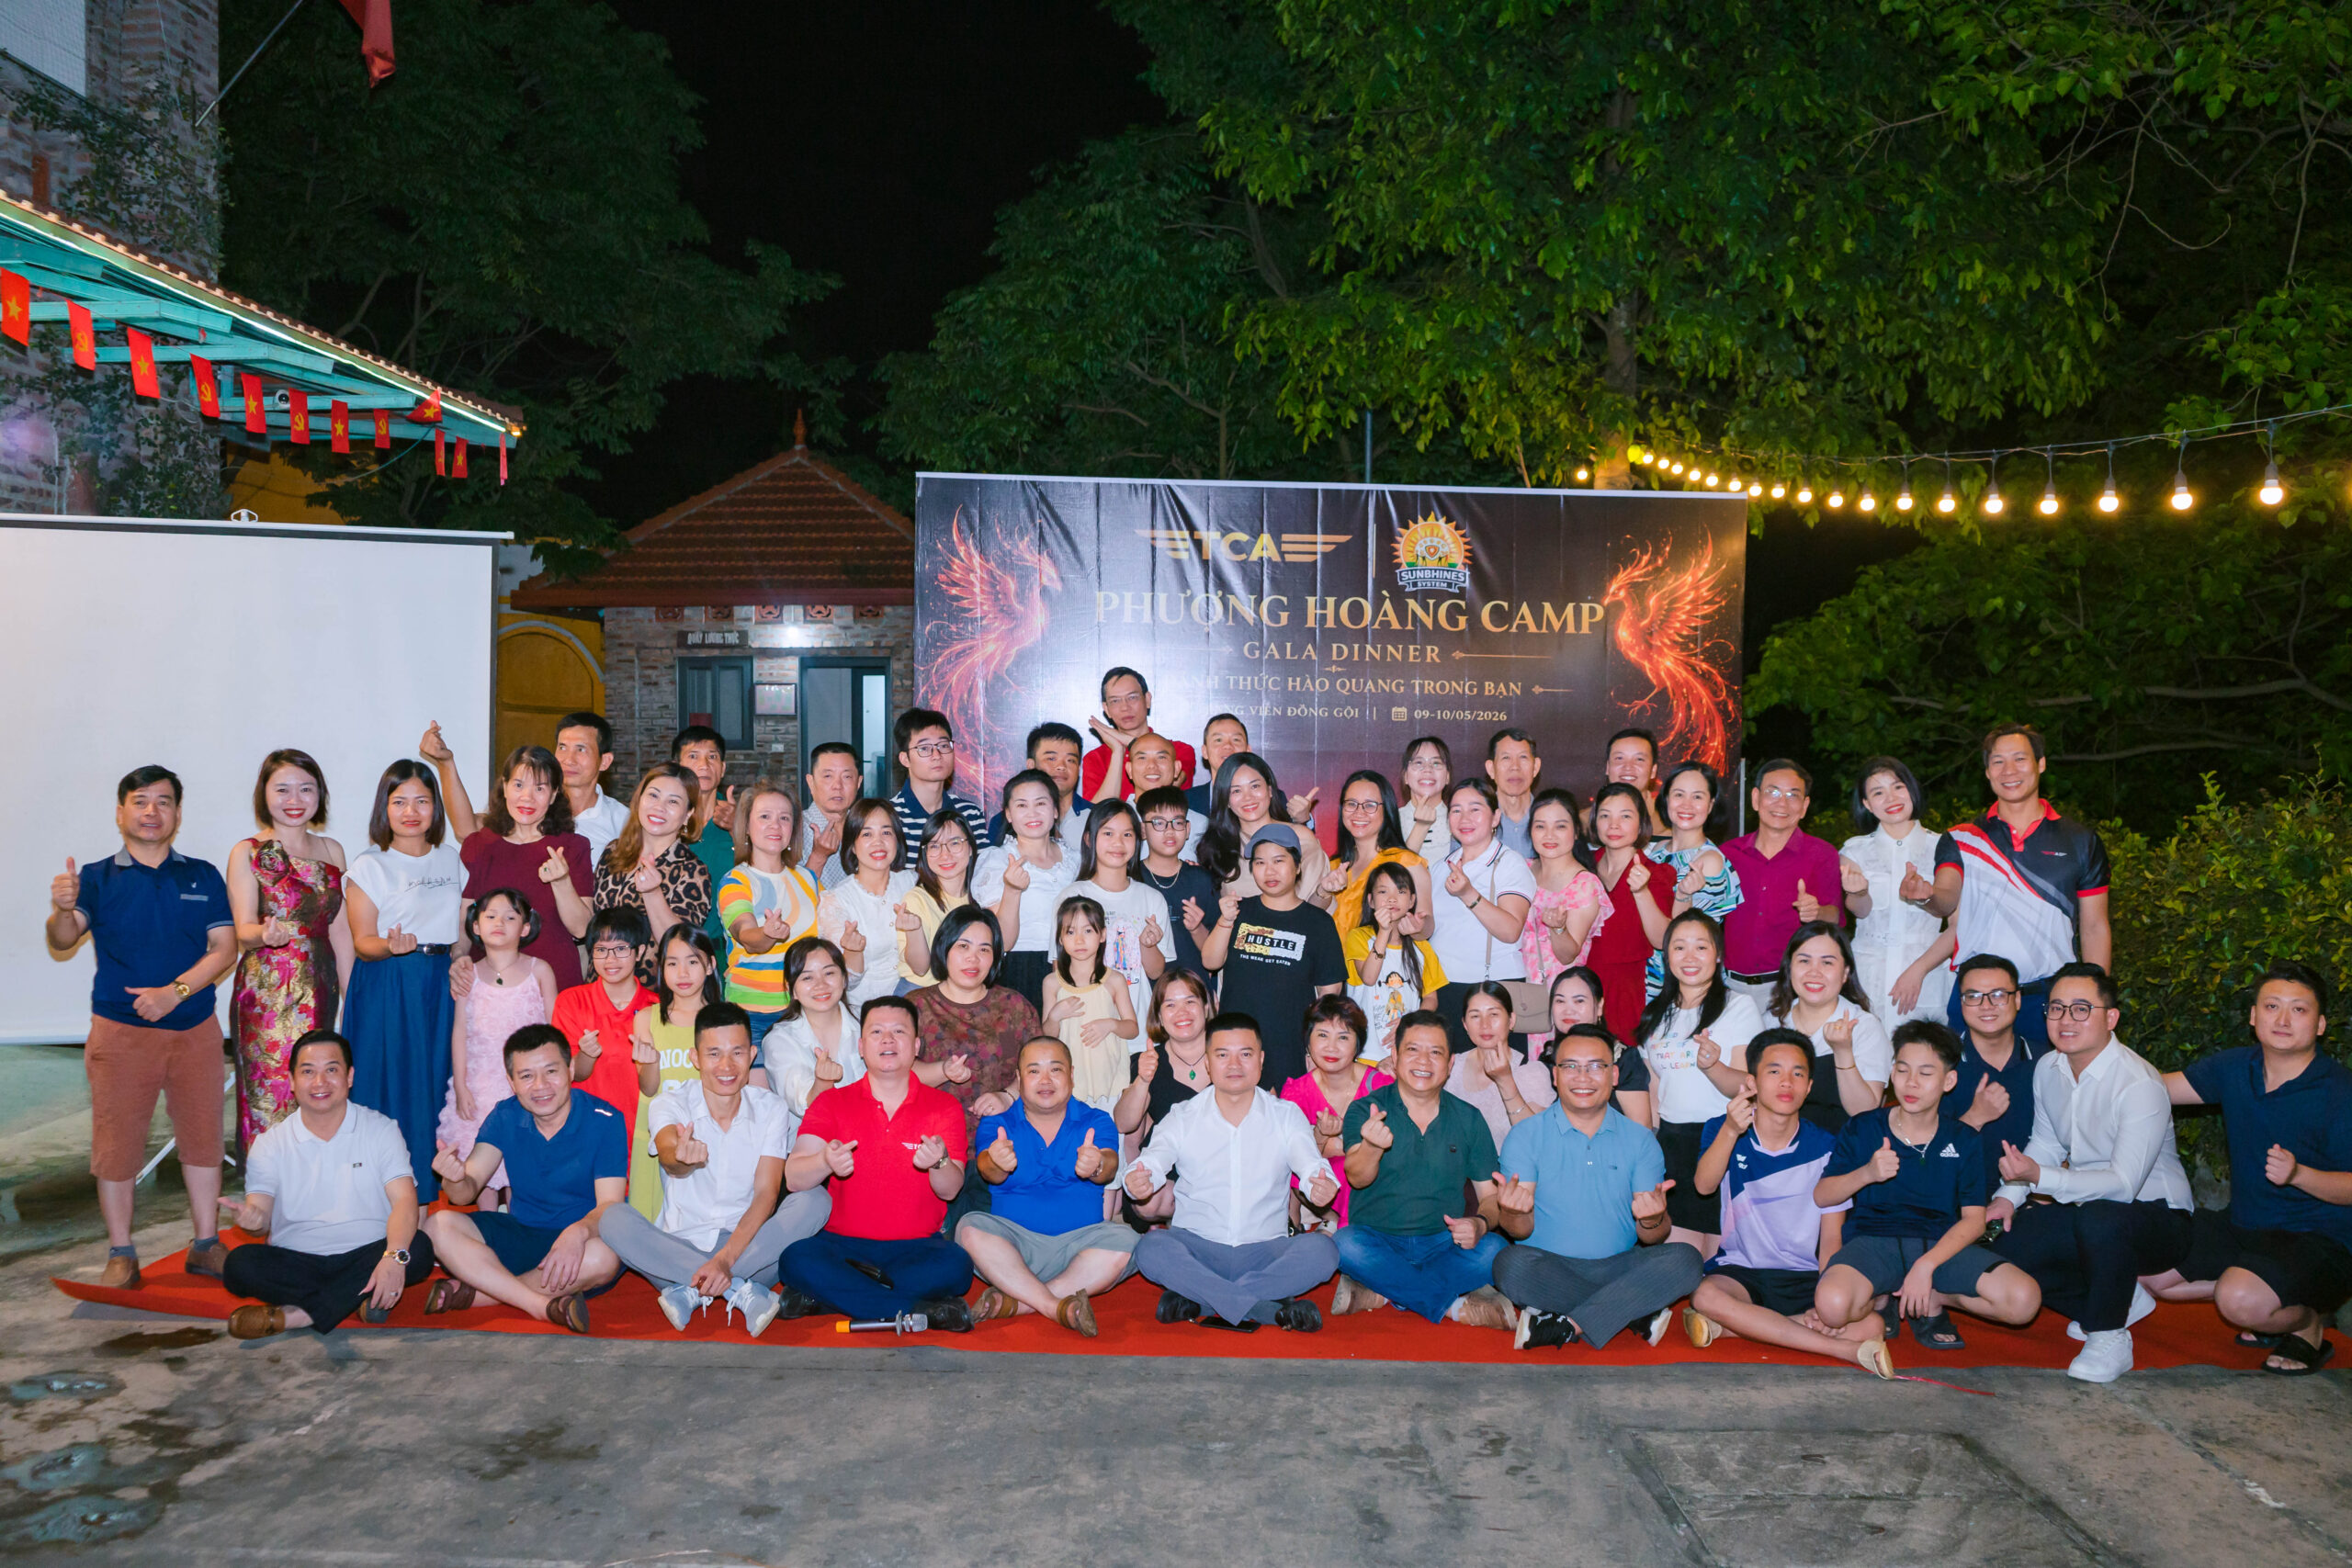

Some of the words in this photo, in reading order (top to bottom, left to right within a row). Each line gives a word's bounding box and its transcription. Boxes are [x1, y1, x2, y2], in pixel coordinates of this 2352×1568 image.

[1400, 570, 1465, 582] SUNBHINES
[1095, 589, 1291, 633] PHƯỢNG
[1305, 590, 1469, 632] HOÀNG
[1480, 600, 1605, 635] CAMP
[1243, 641, 1317, 660] GALA
[1331, 643, 1442, 663] DINNER
[1226, 672, 1281, 691] THỨC
[1287, 673, 1330, 692] HÀO
[1336, 678, 1405, 695] QUANG
[1411, 680, 1478, 696] TRONG
[1484, 682, 1522, 699] BẠN
[1414, 709, 1508, 721] 09-10/05/2026
[1247, 934, 1295, 950] HUSTLE
